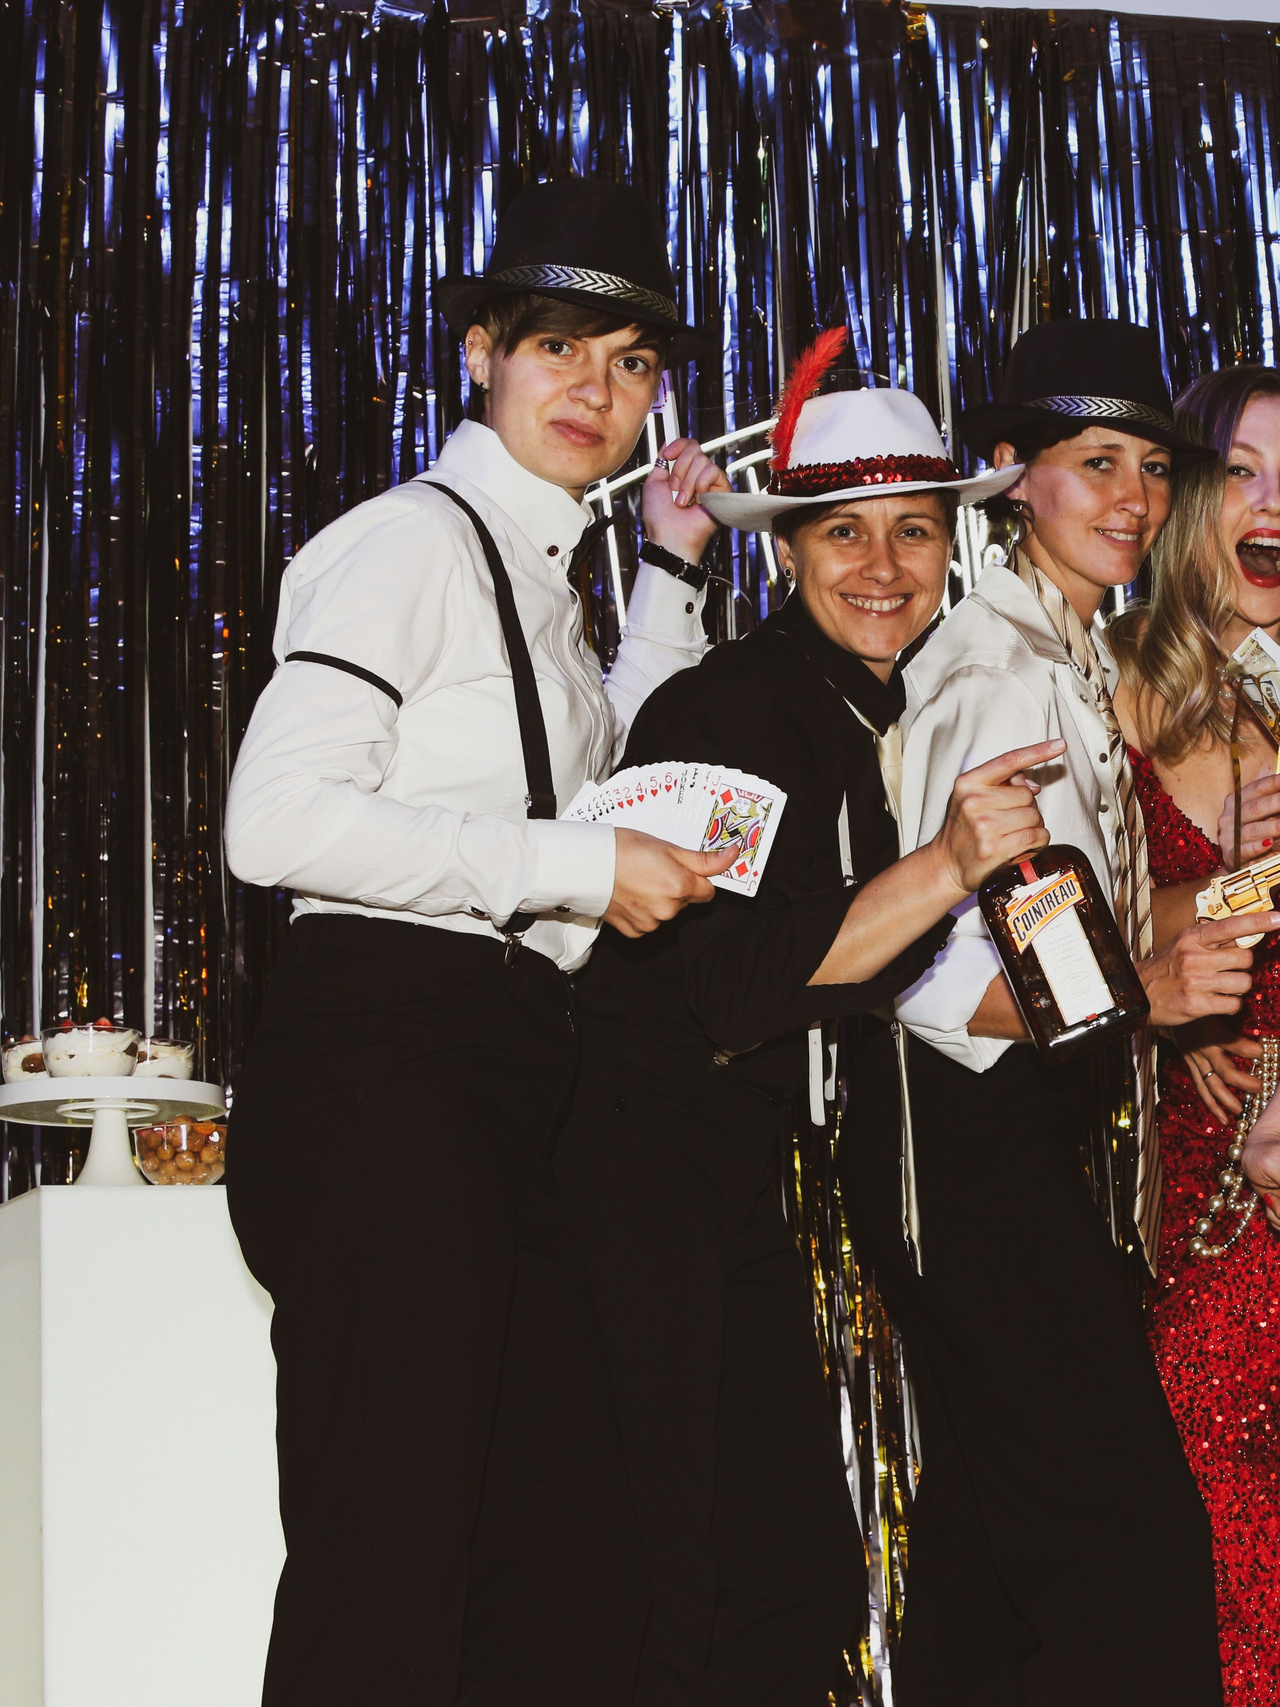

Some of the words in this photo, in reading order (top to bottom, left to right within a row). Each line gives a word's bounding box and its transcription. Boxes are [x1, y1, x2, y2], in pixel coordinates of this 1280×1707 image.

[650, 776, 658, 788] 5
[665, 772, 672, 784] 6
[623, 787, 632, 799] 2
[636, 782, 643, 793] 4
[1013, 879, 1077, 942] COINTREAU
